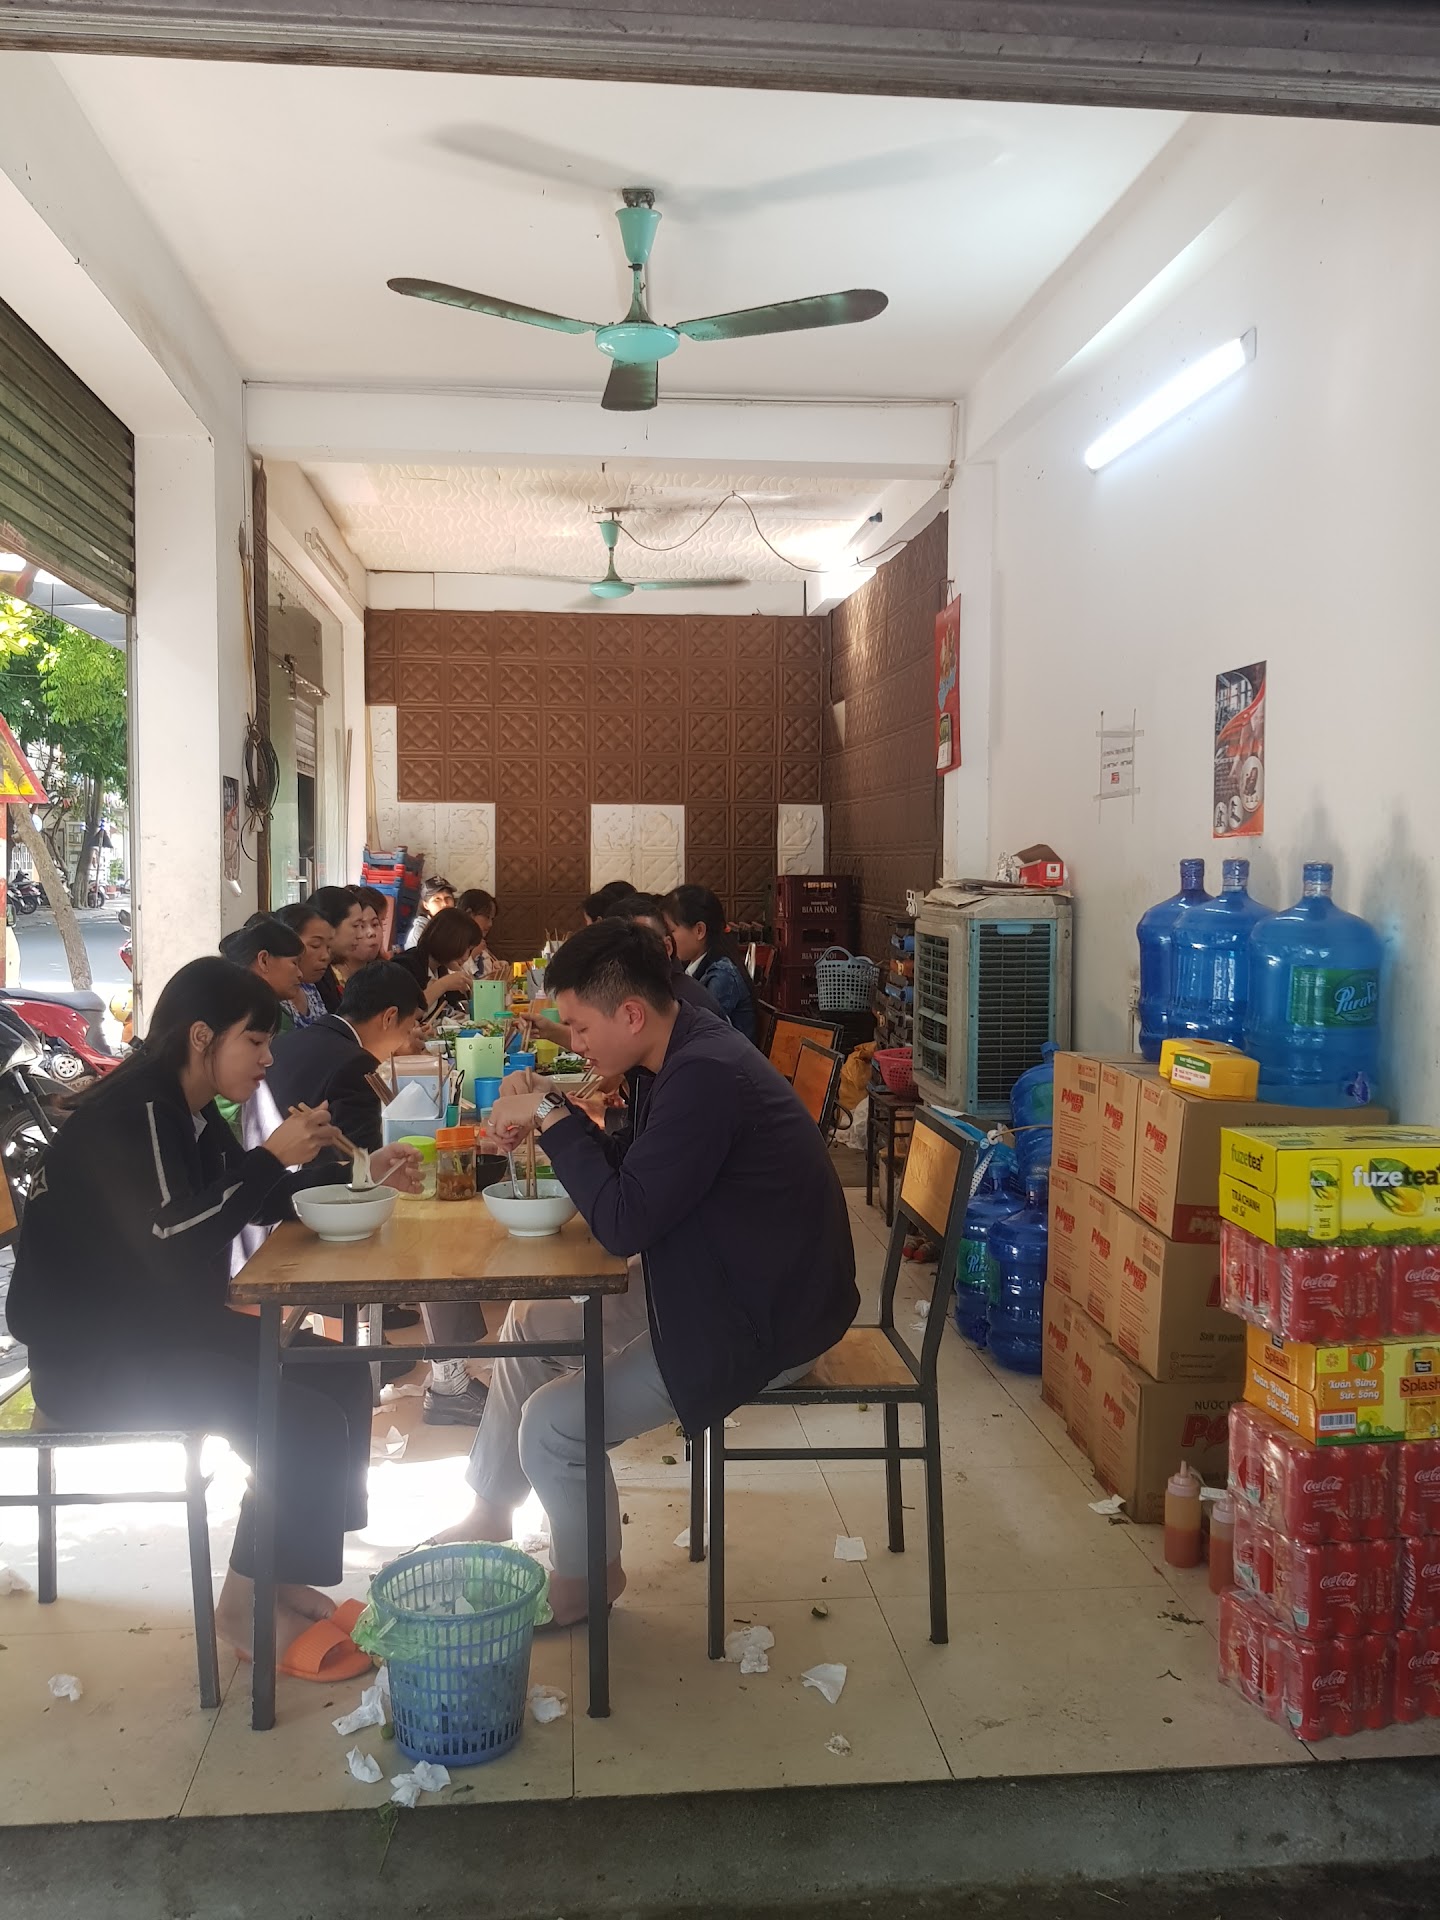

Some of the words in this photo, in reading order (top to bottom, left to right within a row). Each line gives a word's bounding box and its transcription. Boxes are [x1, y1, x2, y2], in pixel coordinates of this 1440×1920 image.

[801, 906, 813, 914] BIA
[825, 904, 837, 914] NỘI
[1401, 1377, 1440, 1395] Splash
